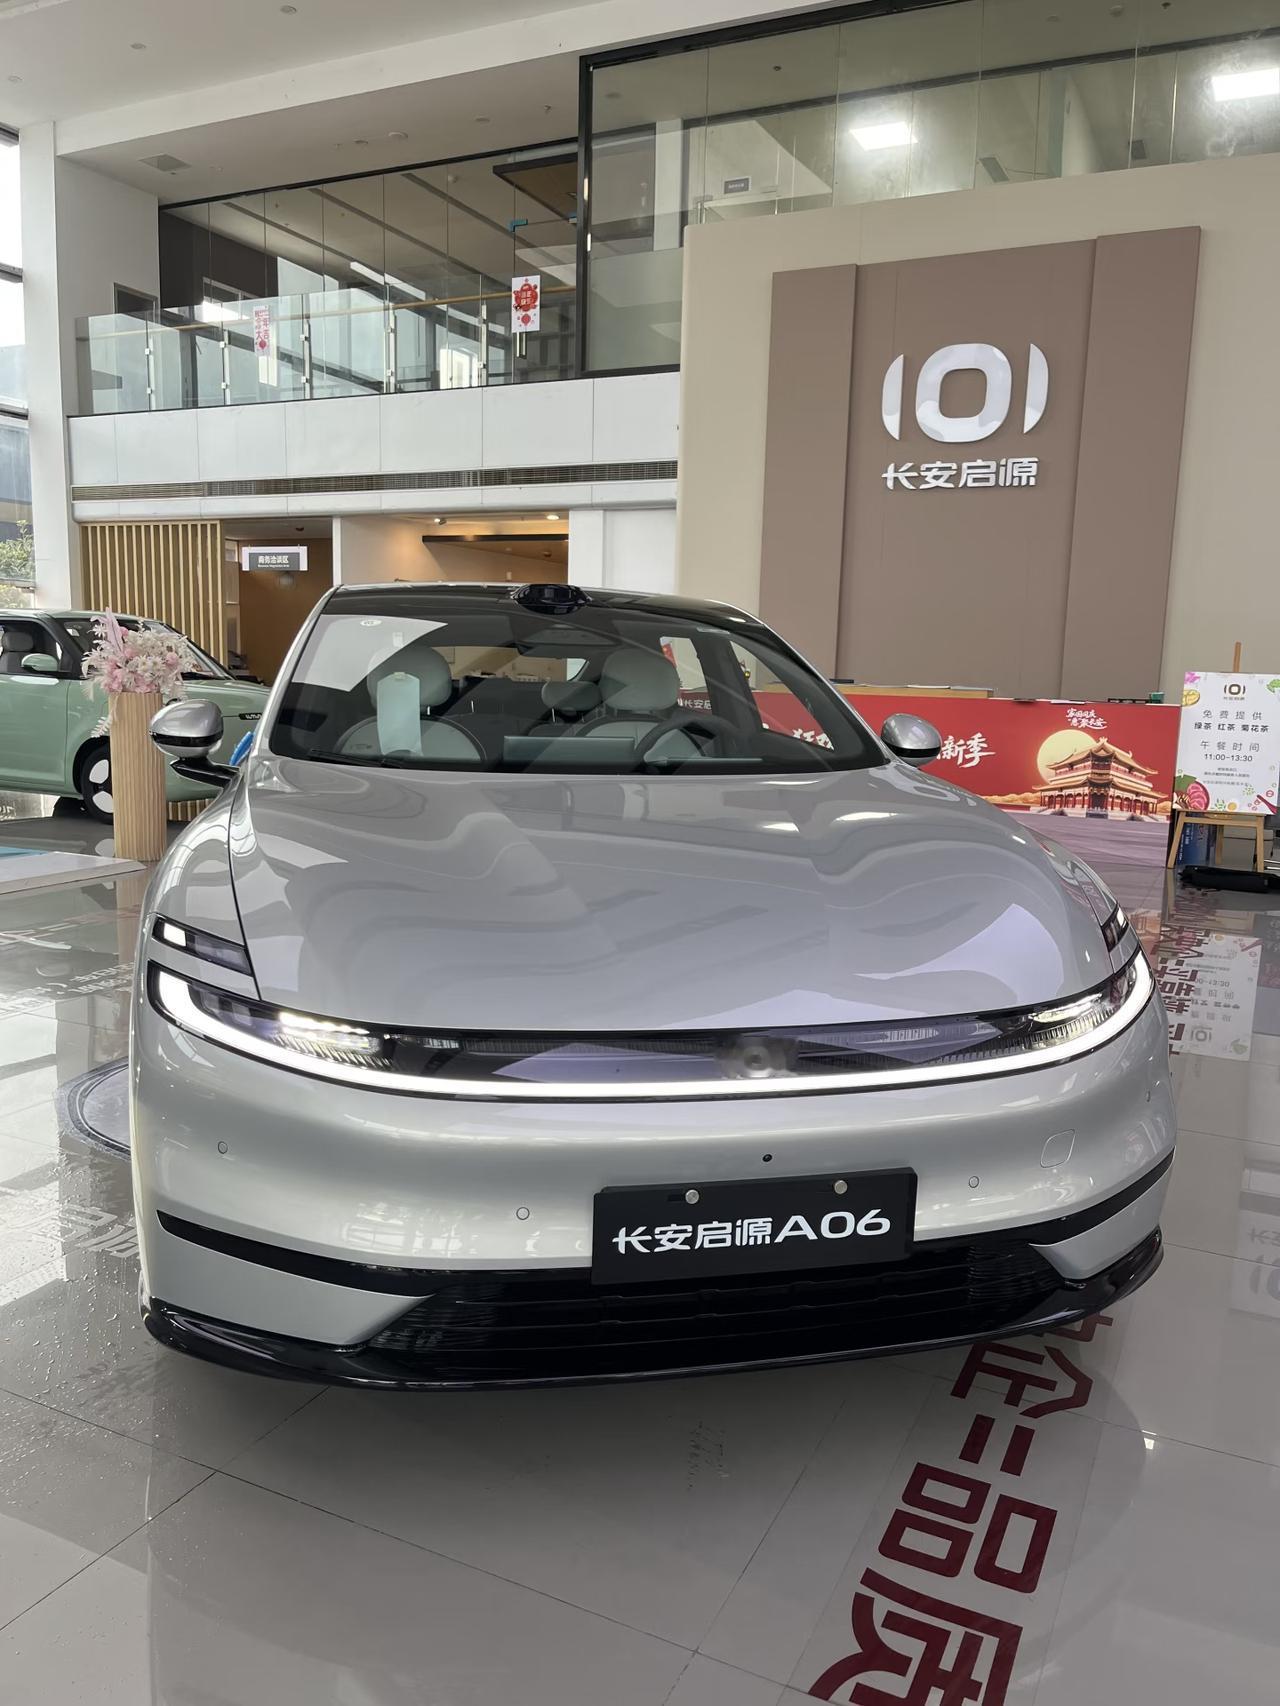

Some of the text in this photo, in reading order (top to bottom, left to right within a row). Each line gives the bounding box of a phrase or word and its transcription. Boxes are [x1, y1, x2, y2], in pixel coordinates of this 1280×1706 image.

[882, 456, 1039, 490] 长安启源
[1203, 709, 1262, 721] 免费提供
[1194, 722, 1269, 732] 绿茶 红茶 菊花茶
[937, 732, 996, 768] 新季
[1200, 740, 1260, 752] 午餐时间
[1204, 753, 1253, 762] 11:00-13:30
